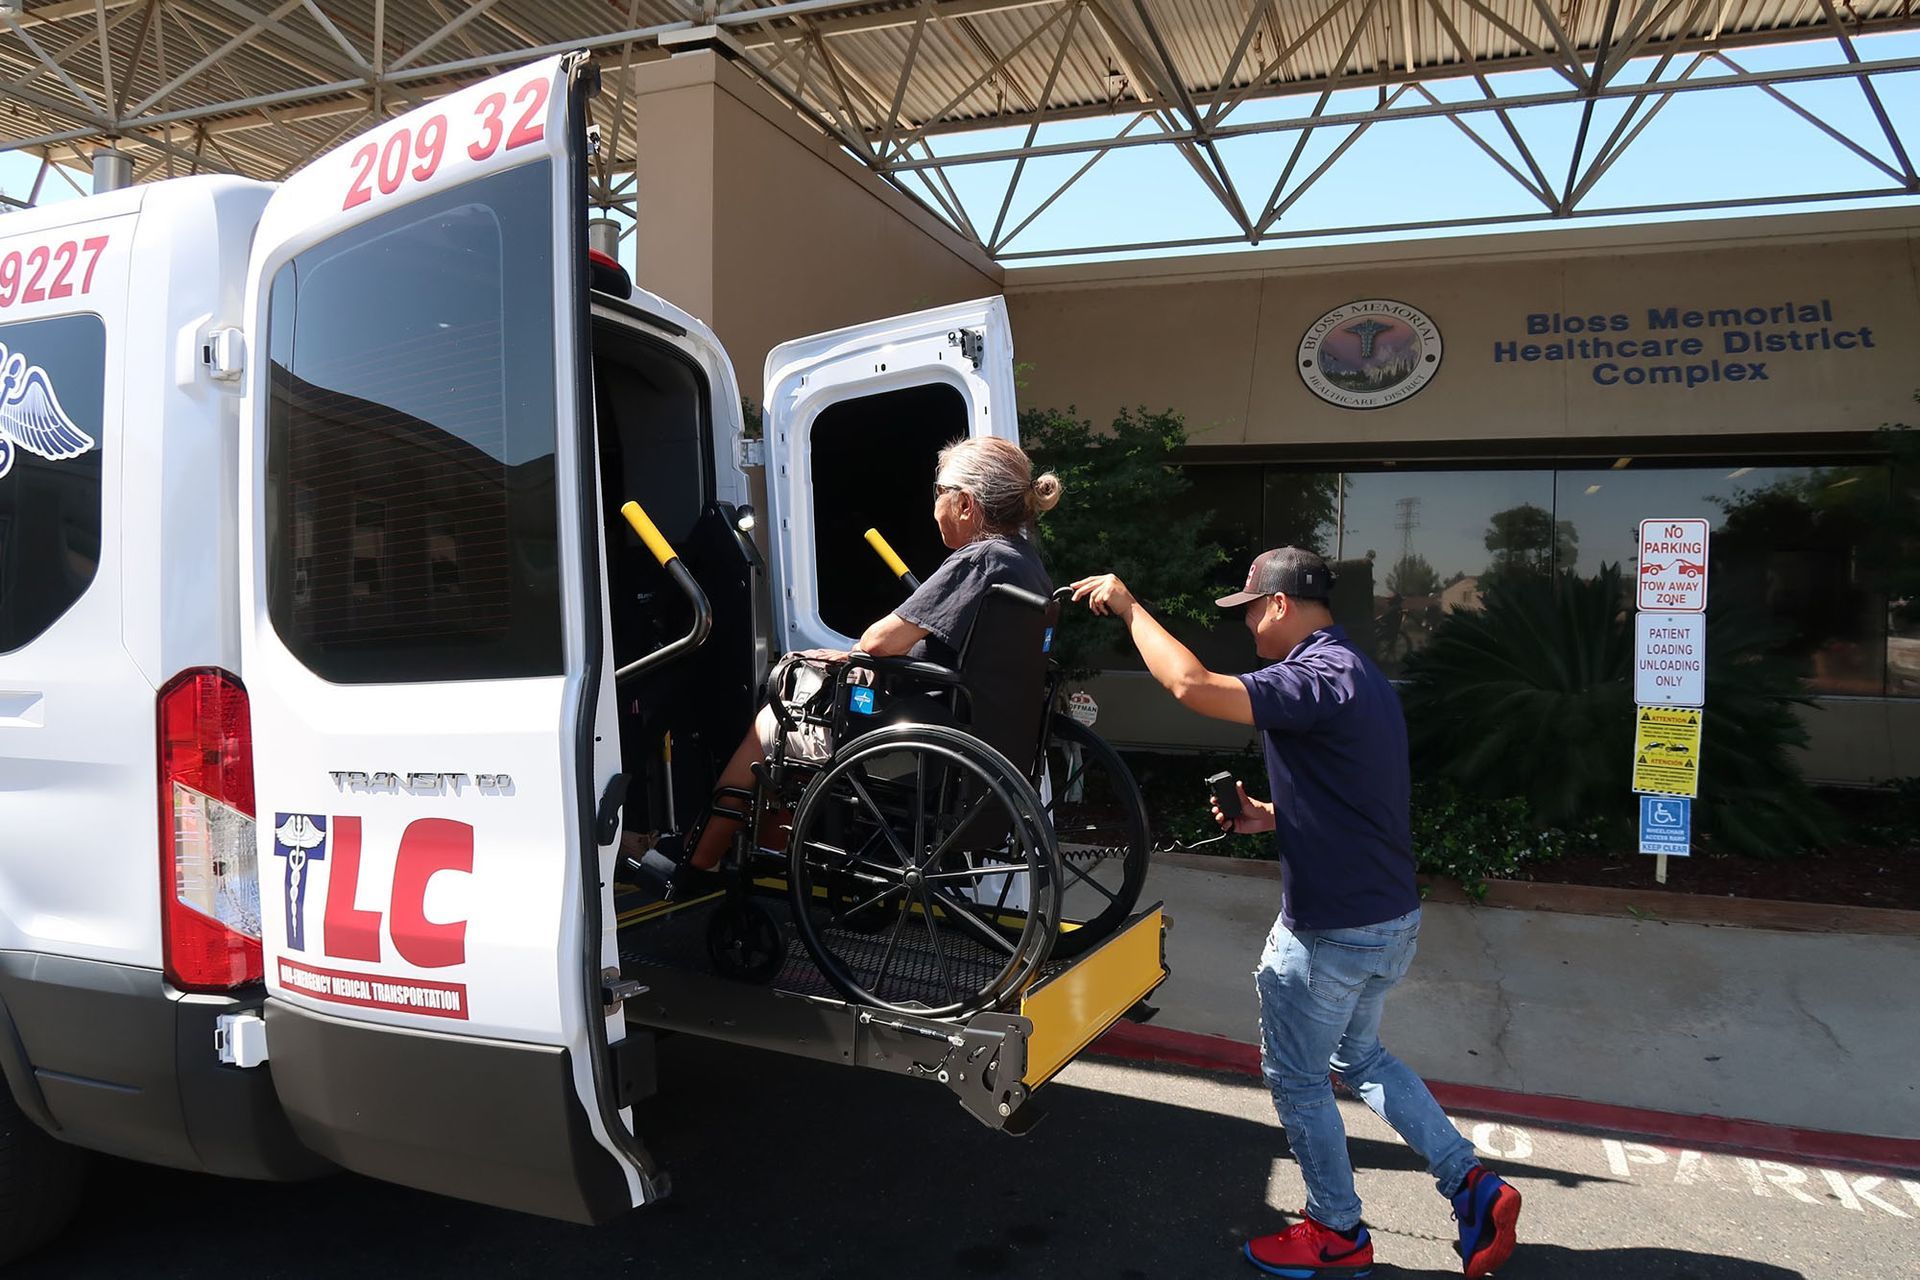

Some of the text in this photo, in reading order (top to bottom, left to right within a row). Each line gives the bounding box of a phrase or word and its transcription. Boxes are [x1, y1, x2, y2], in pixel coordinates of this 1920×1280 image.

[342, 76, 550, 212] 209 32
[0, 234, 110, 308] 9227
[1304, 303, 1436, 350] BLOSS MEMORIAL
[1526, 300, 1833, 335] Bloss Memorial
[1494, 326, 1875, 363] Healthcare District
[1592, 360, 1769, 388] Complex
[1309, 374, 1425, 405] HEALTHCARE DISTRICT
[1664, 527, 1683, 539] NO
[1644, 542, 1702, 554] PARKING
[1641, 581, 1699, 591] TOW AWAY
[1656, 593, 1686, 604] ZONE
[1650, 628, 1691, 639] PATIENT
[1647, 644, 1693, 655] LOADING
[1640, 660, 1700, 671] UNLOADING
[1656, 675, 1682, 687] ONLY
[328, 771, 470, 791] TRANSIT
[1642, 843, 1661, 851] KEEP
[274, 812, 474, 968] TLC
[332, 976, 372, 1000] MEDICAL
[371, 982, 461, 1011] TRANSPORTATION
